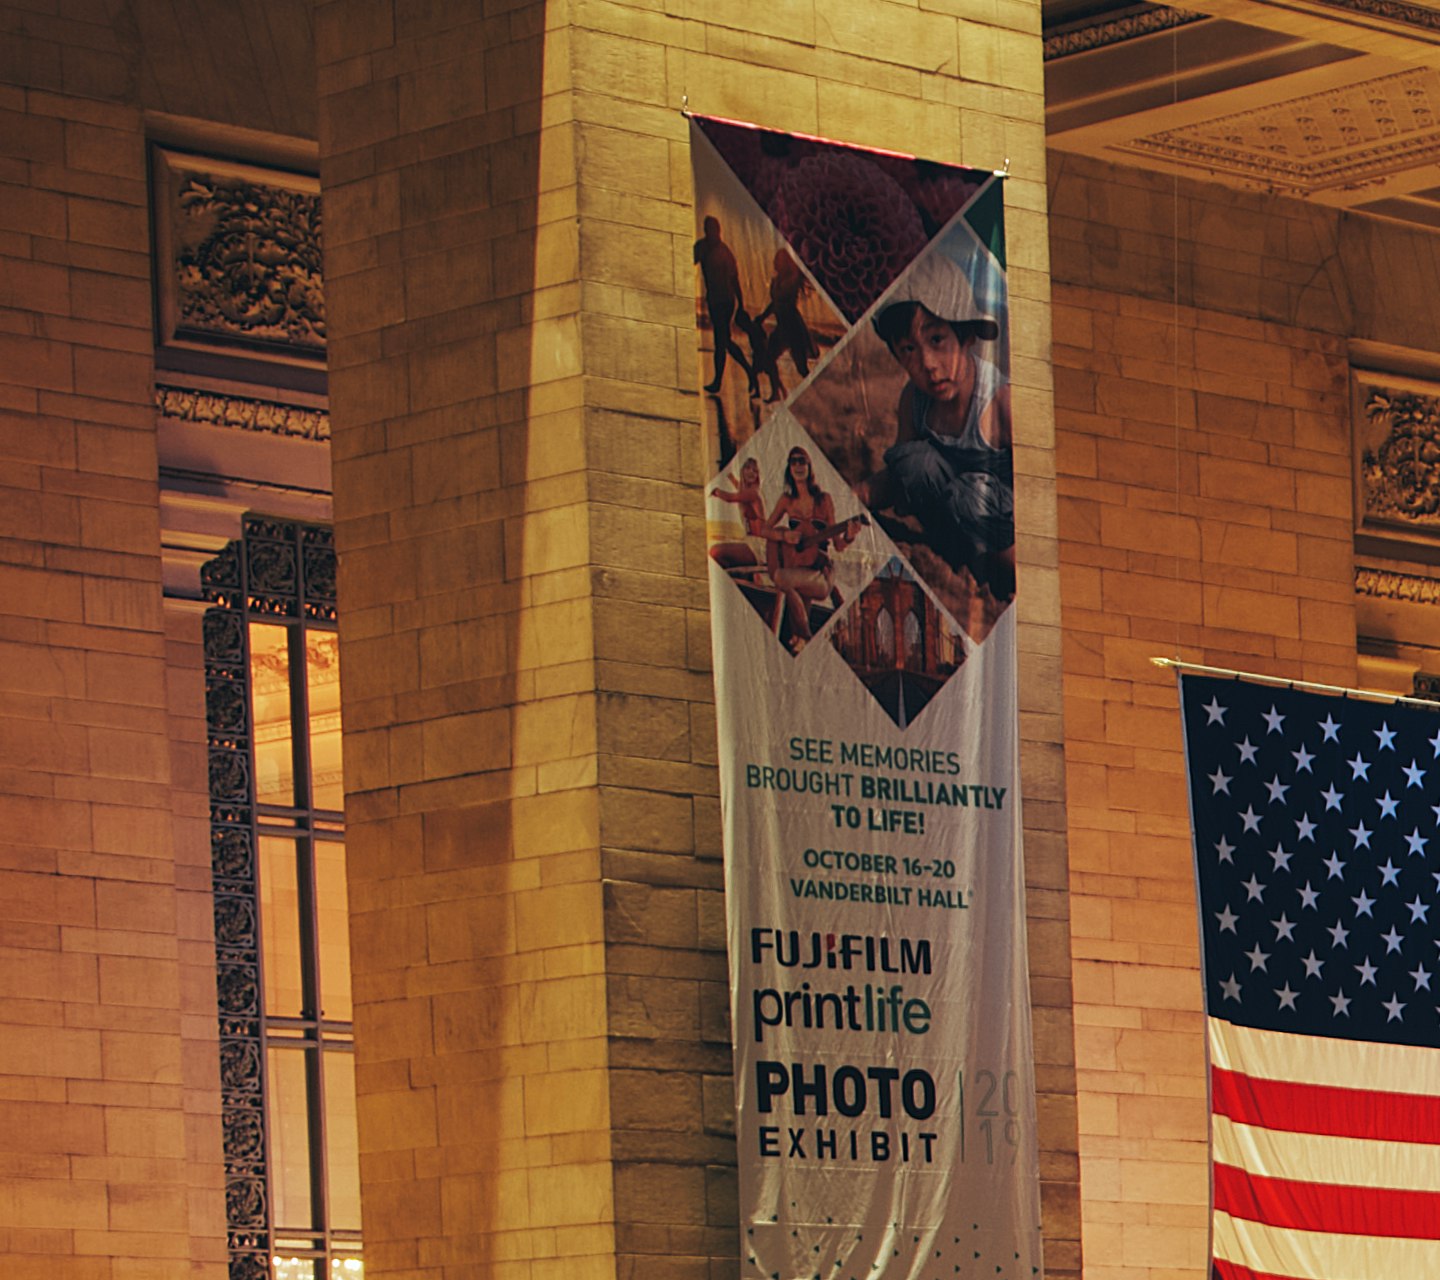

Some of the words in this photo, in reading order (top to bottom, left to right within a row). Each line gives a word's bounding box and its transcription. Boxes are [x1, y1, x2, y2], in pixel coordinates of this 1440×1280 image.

[790, 737, 833, 763] SEE
[840, 742, 960, 775] MEMORIES
[746, 764, 853, 796] BROUGHT
[861, 776, 1007, 809] BRILLIANTLY
[831, 805, 861, 829] TO
[868, 808, 925, 834] LIFE!
[803, 849, 897, 874] OCTOBER
[903, 858, 955, 878] 16-20
[790, 879, 912, 905] VANDERBILT
[752, 928, 932, 975] FUJIFILM
[754, 982, 931, 1042] printlife
[756, 1060, 936, 1120] PHOTO
[759, 1126, 938, 1163] EXHIBIT
